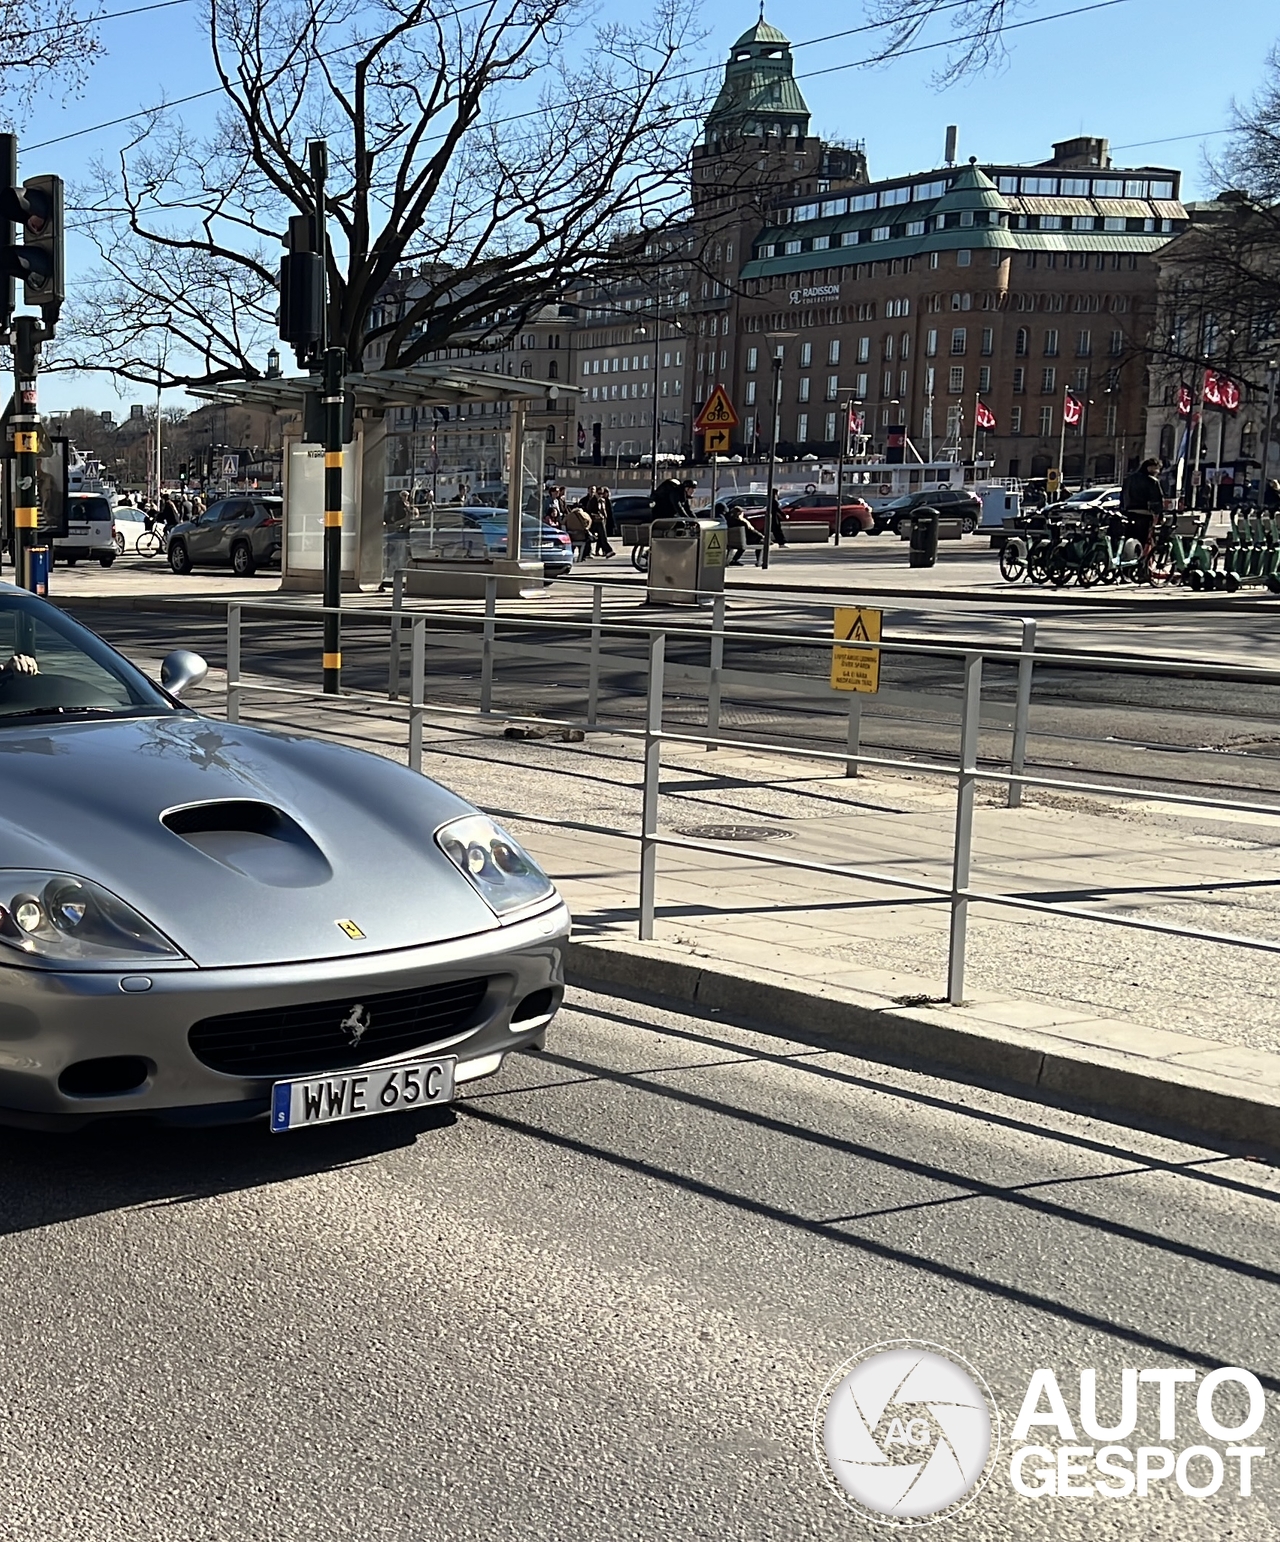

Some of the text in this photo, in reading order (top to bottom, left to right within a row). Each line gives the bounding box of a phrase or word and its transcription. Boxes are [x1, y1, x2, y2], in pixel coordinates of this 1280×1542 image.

[803, 285, 840, 297] RADISSON
[277, 1063, 444, 1123] S WWE 65C
